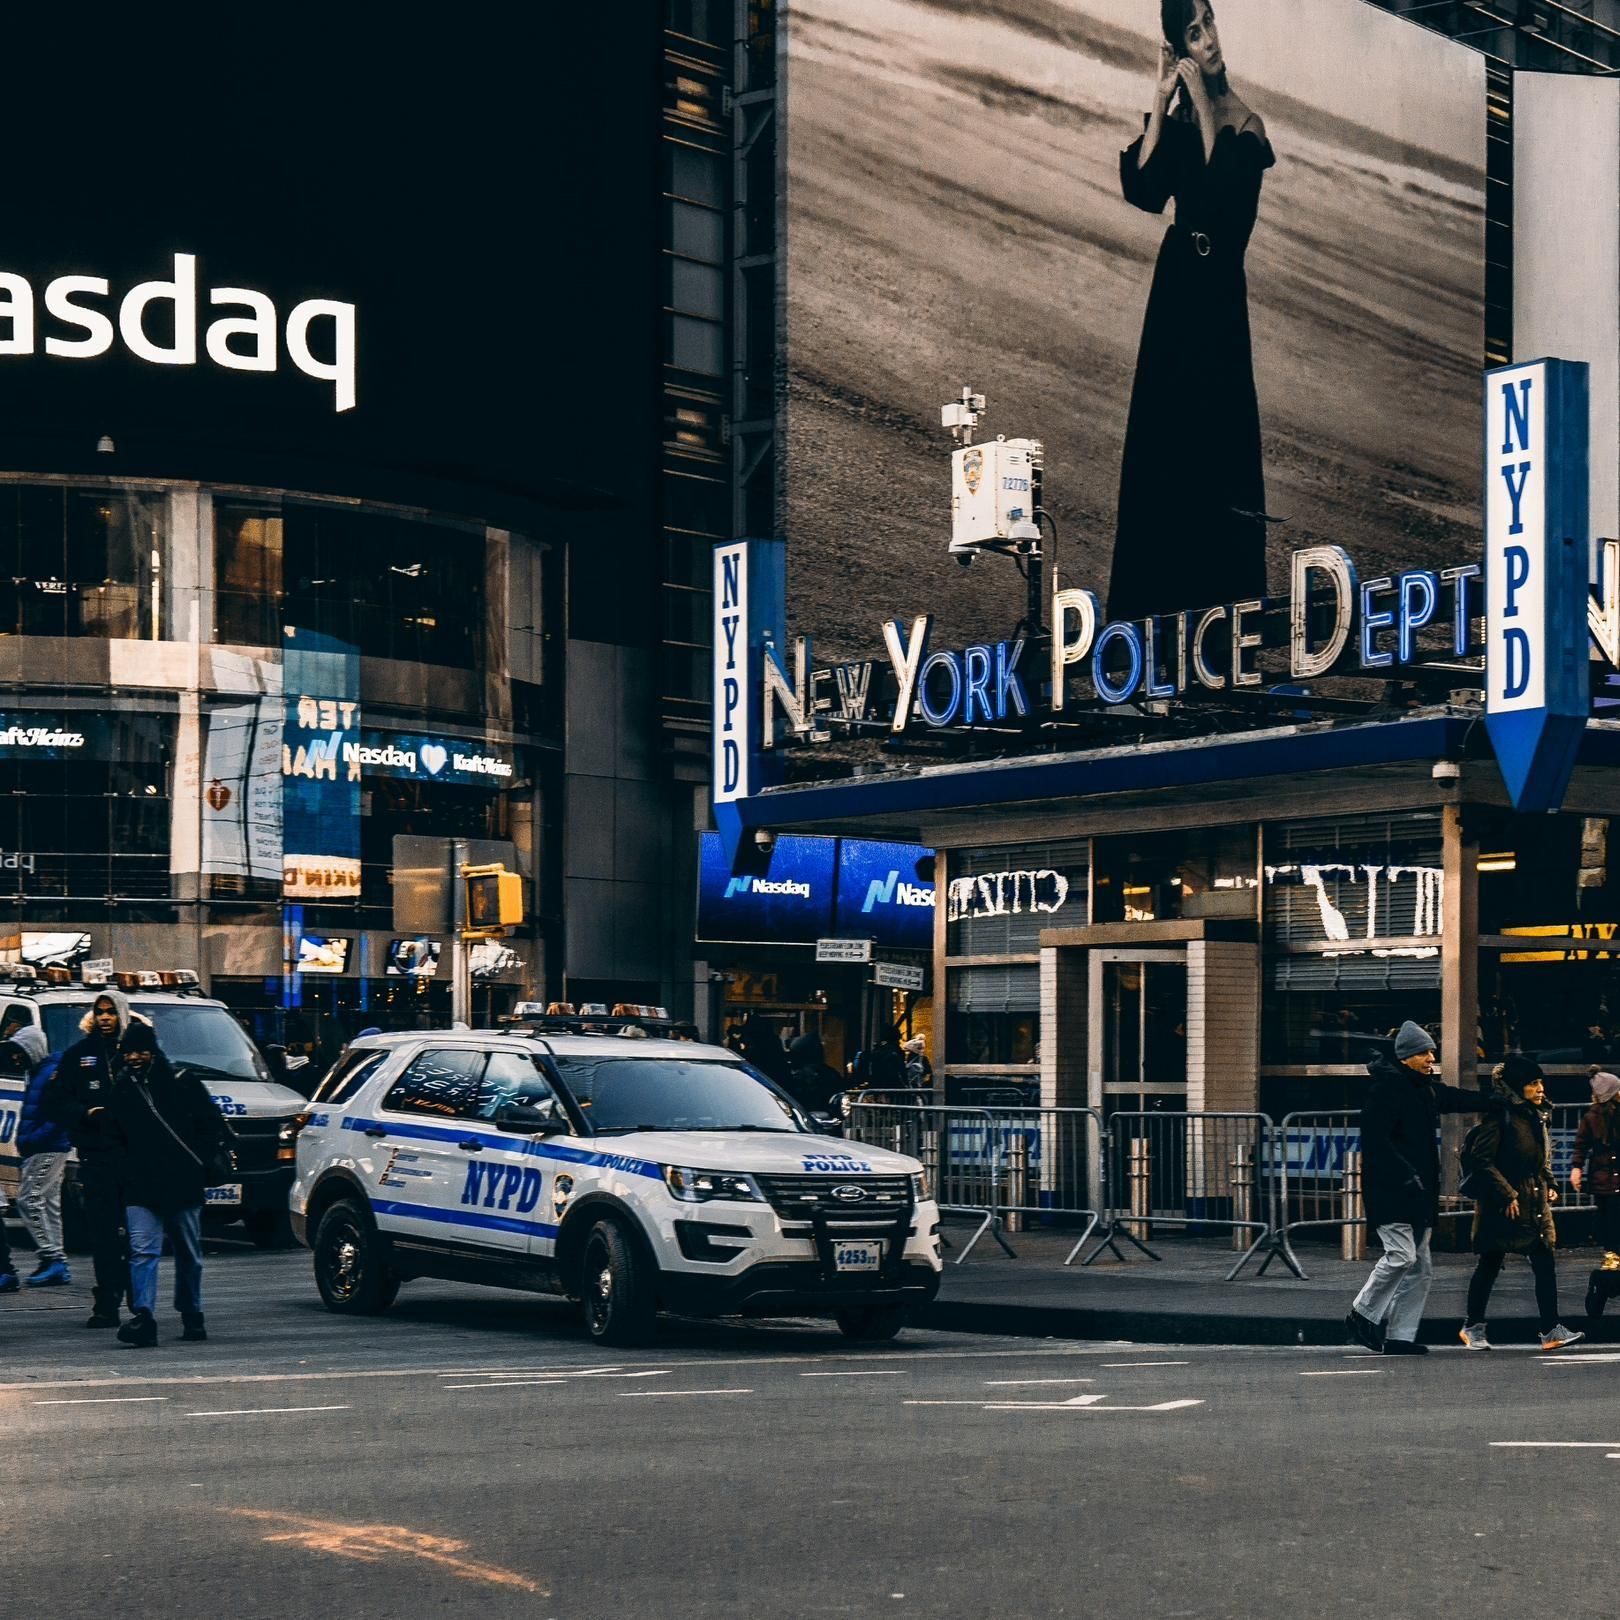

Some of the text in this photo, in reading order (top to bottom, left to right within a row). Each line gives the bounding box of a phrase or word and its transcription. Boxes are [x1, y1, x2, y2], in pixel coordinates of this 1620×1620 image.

[1502, 378, 1532, 700] NYPD
[763, 545, 1482, 749] NEW YORK POLICE DEPT
[722, 553, 740, 792] NYPD
[342, 741, 416, 772] Nasdaq
[0, 847, 36, 874] aq
[752, 879, 810, 899] Nasdaq
[602, 1154, 644, 1174] POLICE
[801, 1160, 872, 1172] POLICE
[460, 1160, 543, 1213] NYPD
[837, 1249, 867, 1265] 4253
